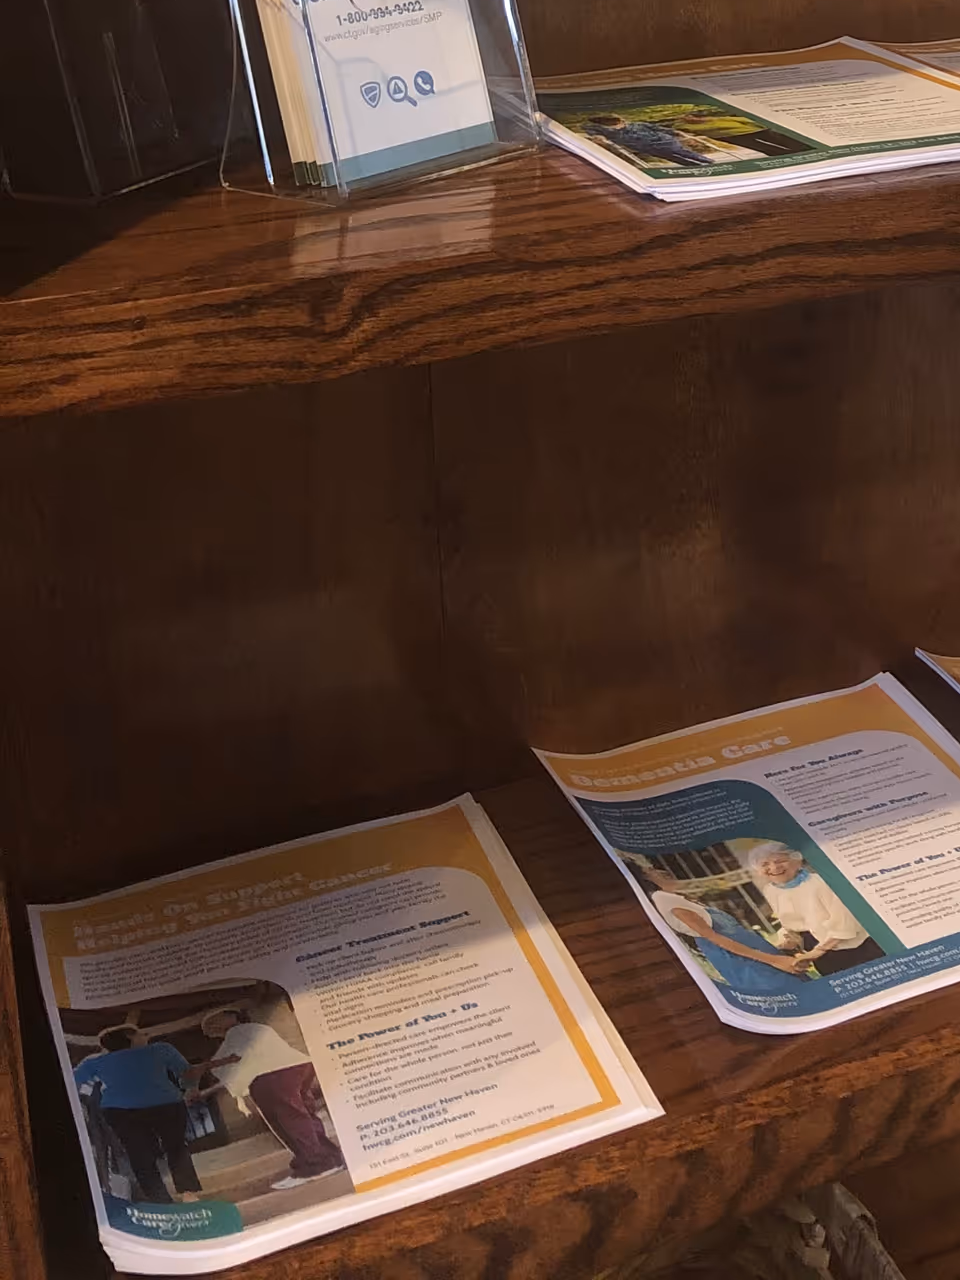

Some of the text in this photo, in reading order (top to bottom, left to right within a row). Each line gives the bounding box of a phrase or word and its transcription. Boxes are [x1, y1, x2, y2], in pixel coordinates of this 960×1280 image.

[719, 735, 791, 758] Care
[346, 925, 415, 948] Treatment
[418, 911, 470, 928] Support
[828, 944, 945, 986] Serving Greater New Haven
[327, 1037, 355, 1050] The
[358, 1023, 401, 1041] Power
[403, 1018, 420, 1028] of
[422, 1010, 446, 1023] You
[459, 1001, 479, 1011] Us
[408, 1030, 427, 1039] care
[428, 1017, 472, 1033] empowers
[472, 1011, 488, 1020] the
[488, 1005, 512, 1015] client
[342, 1017, 503, 1068] Adherence improves when meaningful
[344, 1044, 438, 1075] connections are made
[346, 1030, 513, 1085] Care for the whole not just their
[349, 1075, 391, 1092] condition
[354, 1042, 536, 1101] Facilitate communication with any involved
[398, 1076, 448, 1095] community
[449, 1065, 486, 1080] partners
[494, 1055, 518, 1066] loved
[519, 1048, 541, 1058] ones
[357, 1083, 498, 1131] Serving Greater New Haven
[374, 1108, 447, 1135] 203.646.8855
[364, 1110, 474, 1148] hwcg.com/newhaven
[125, 1207, 213, 1221] Homewatch
